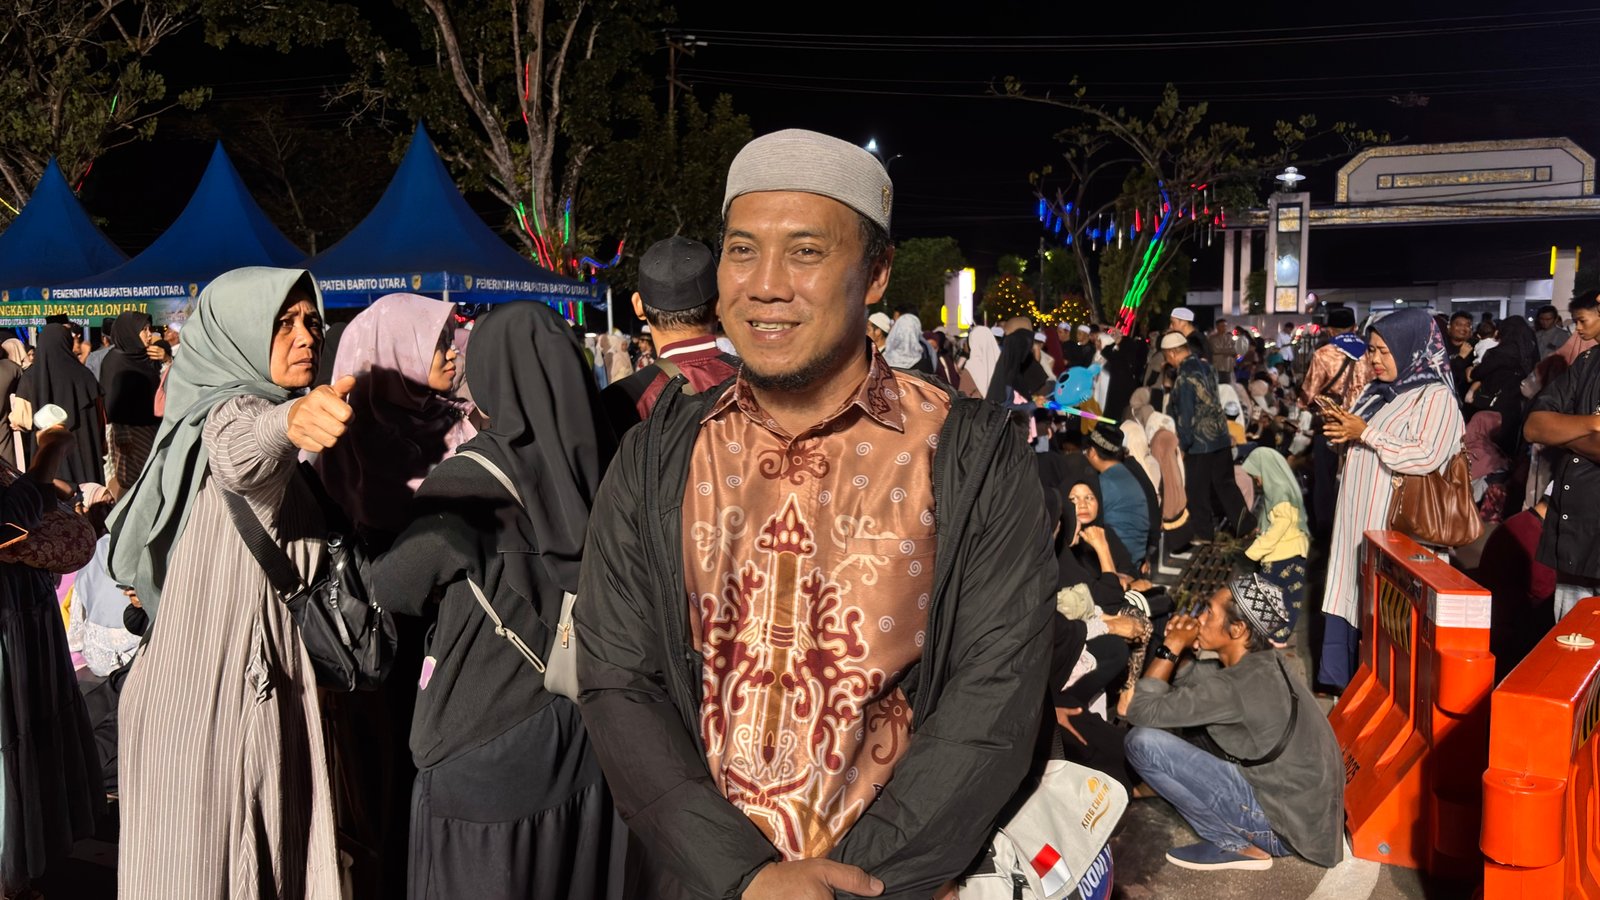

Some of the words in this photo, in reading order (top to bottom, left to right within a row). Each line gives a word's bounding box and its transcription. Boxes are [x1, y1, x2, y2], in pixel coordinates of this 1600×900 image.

[346, 279, 378, 290] BARITO
[378, 277, 407, 289] UTARA
[549, 283, 570, 294] BARITO
[570, 285, 589, 295] UTARA
[52, 288, 93, 299] PEMERINTAH
[93, 287, 132, 297] KABUPATEN
[132, 286, 160, 297] BARITO
[160, 285, 185, 295] UTARA
[86, 303, 121, 316] CALON
[1081, 807, 1096, 830] KING
